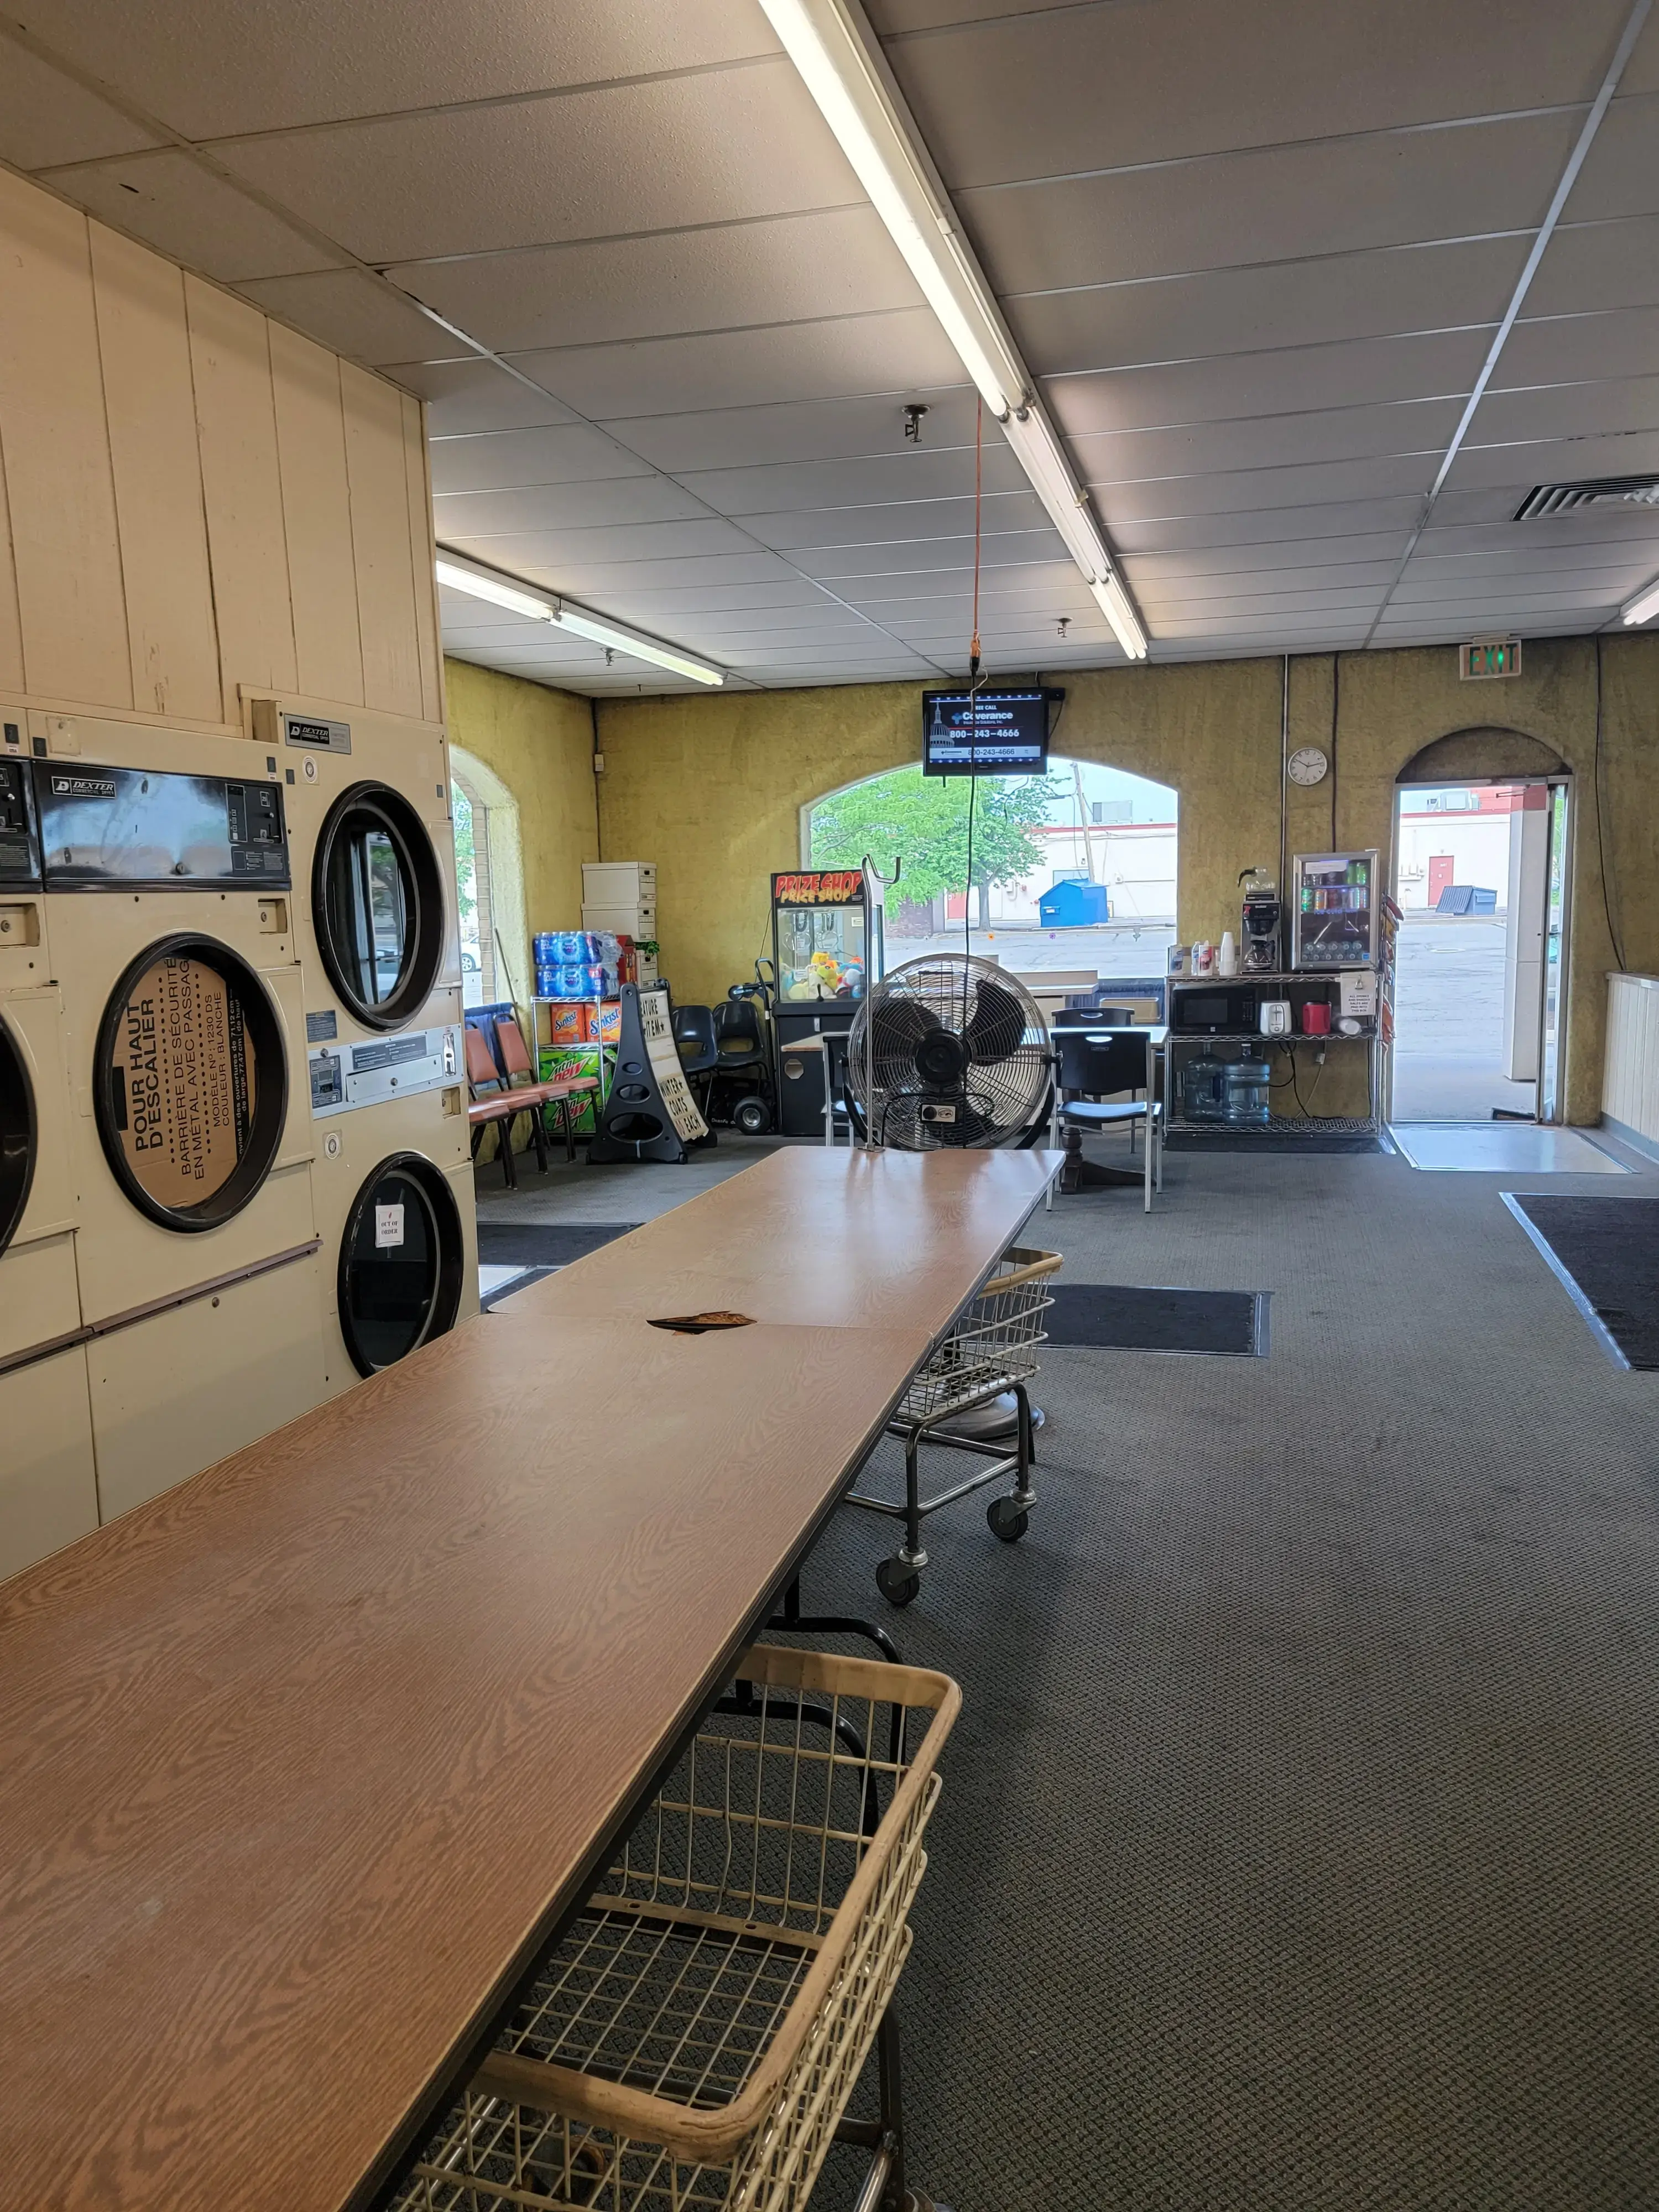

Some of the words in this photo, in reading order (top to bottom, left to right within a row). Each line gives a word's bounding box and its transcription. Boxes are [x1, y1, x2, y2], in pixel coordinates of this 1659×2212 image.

[1469, 644, 1517, 676] EXIT
[302, 727, 328, 737] DEXTER
[72, 781, 113, 791] DEXTER
[775, 874, 821, 898] PRIZE
[821, 872, 863, 895] SHOP
[780, 889, 816, 904] PRIZE
[818, 888, 850, 902] SHOP
[164, 958, 182, 1048] SÉCURITÉ
[180, 960, 194, 1033] PASSAG
[205, 995, 212, 1012] DS
[230, 1000, 234, 1014] cm
[214, 992, 224, 1053] BLANCHE
[237, 1021, 241, 1031] de
[555, 1011, 577, 1031] Sunkist
[590, 1008, 619, 1035] Snkist
[645, 1019, 661, 1037] ITEM
[127, 1001, 143, 1071] HAUT
[231, 1041, 237, 1051] de
[141, 999, 163, 1149] D'ESCALIER
[174, 1054, 184, 1078] DE
[185, 1039, 197, 1086] AVEC
[210, 1072, 220, 1127] MODÈLE
[218, 1064, 229, 1126] COULEUR
[659, 1078, 681, 1098] WINTER
[131, 1079, 148, 1151] POUR
[242, 1100, 246, 1111] de
[669, 1097, 688, 1116] COATS
[175, 1084, 191, 1175] BARRIÈRE
[189, 1091, 202, 1150] MÉTAL
[684, 1113, 701, 1133] EACH
[194, 1152, 204, 1180] EN
